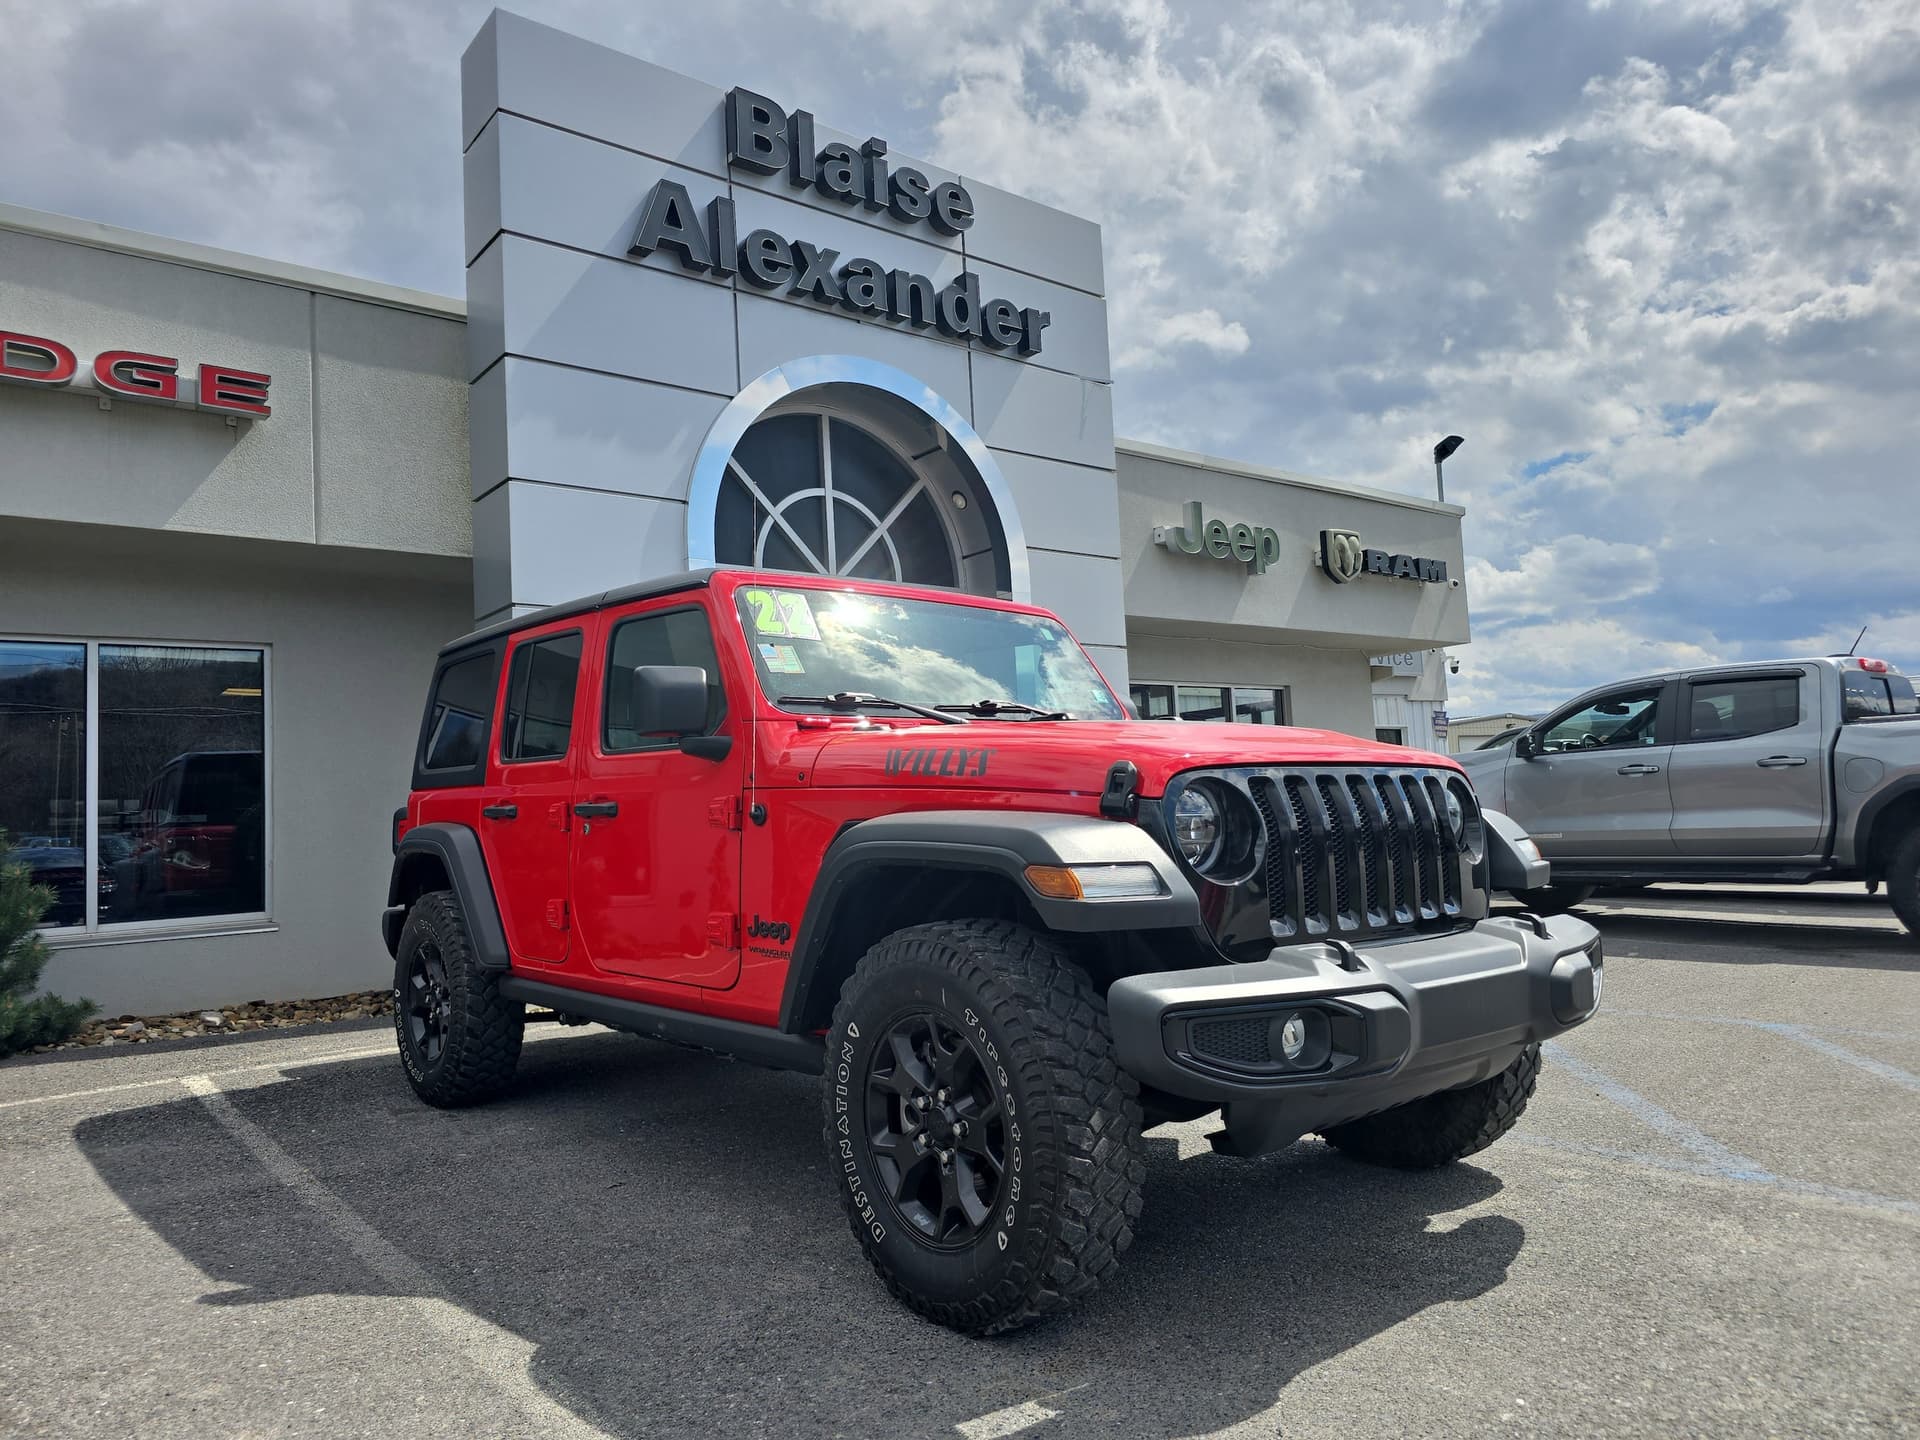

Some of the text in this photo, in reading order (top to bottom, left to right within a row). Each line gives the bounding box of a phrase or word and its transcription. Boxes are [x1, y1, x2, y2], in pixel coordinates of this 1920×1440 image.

[725, 86, 975, 237] Blaise
[627, 178, 1051, 357] Alexander
[1165, 500, 1281, 576] Jeep
[1361, 548, 1448, 583] RAM
[884, 747, 998, 777] WILLYS
[747, 913, 791, 945] Jeep
[836, 1040, 887, 1244] DESTINATION
